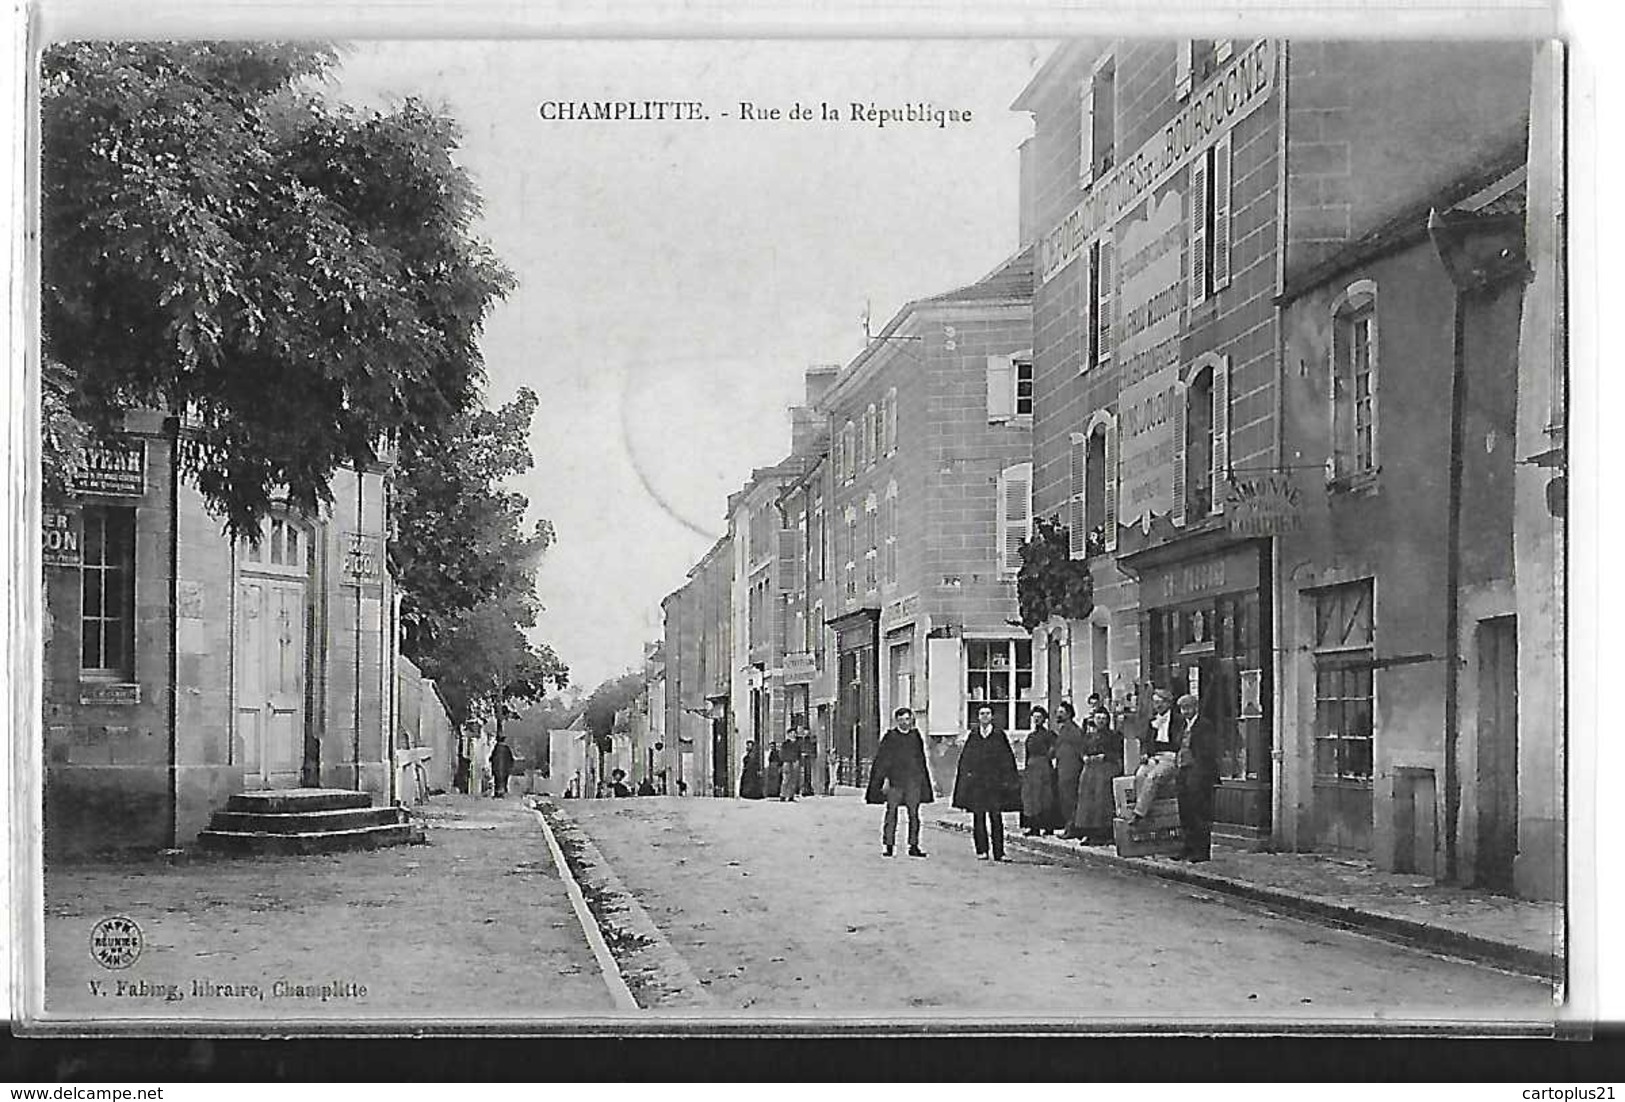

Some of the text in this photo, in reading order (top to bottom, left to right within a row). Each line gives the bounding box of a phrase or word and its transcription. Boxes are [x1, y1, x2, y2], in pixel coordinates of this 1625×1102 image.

[539, 101, 710, 121] CHAMPLITTE.
[738, 102, 782, 121] Rue
[788, 102, 813, 121] de
[821, 102, 840, 121] la
[849, 102, 973, 128] République
[1165, 37, 1268, 170] BOURGOGNE
[89, 980, 107, 997] V.
[272, 979, 369, 1002] Champlitte
